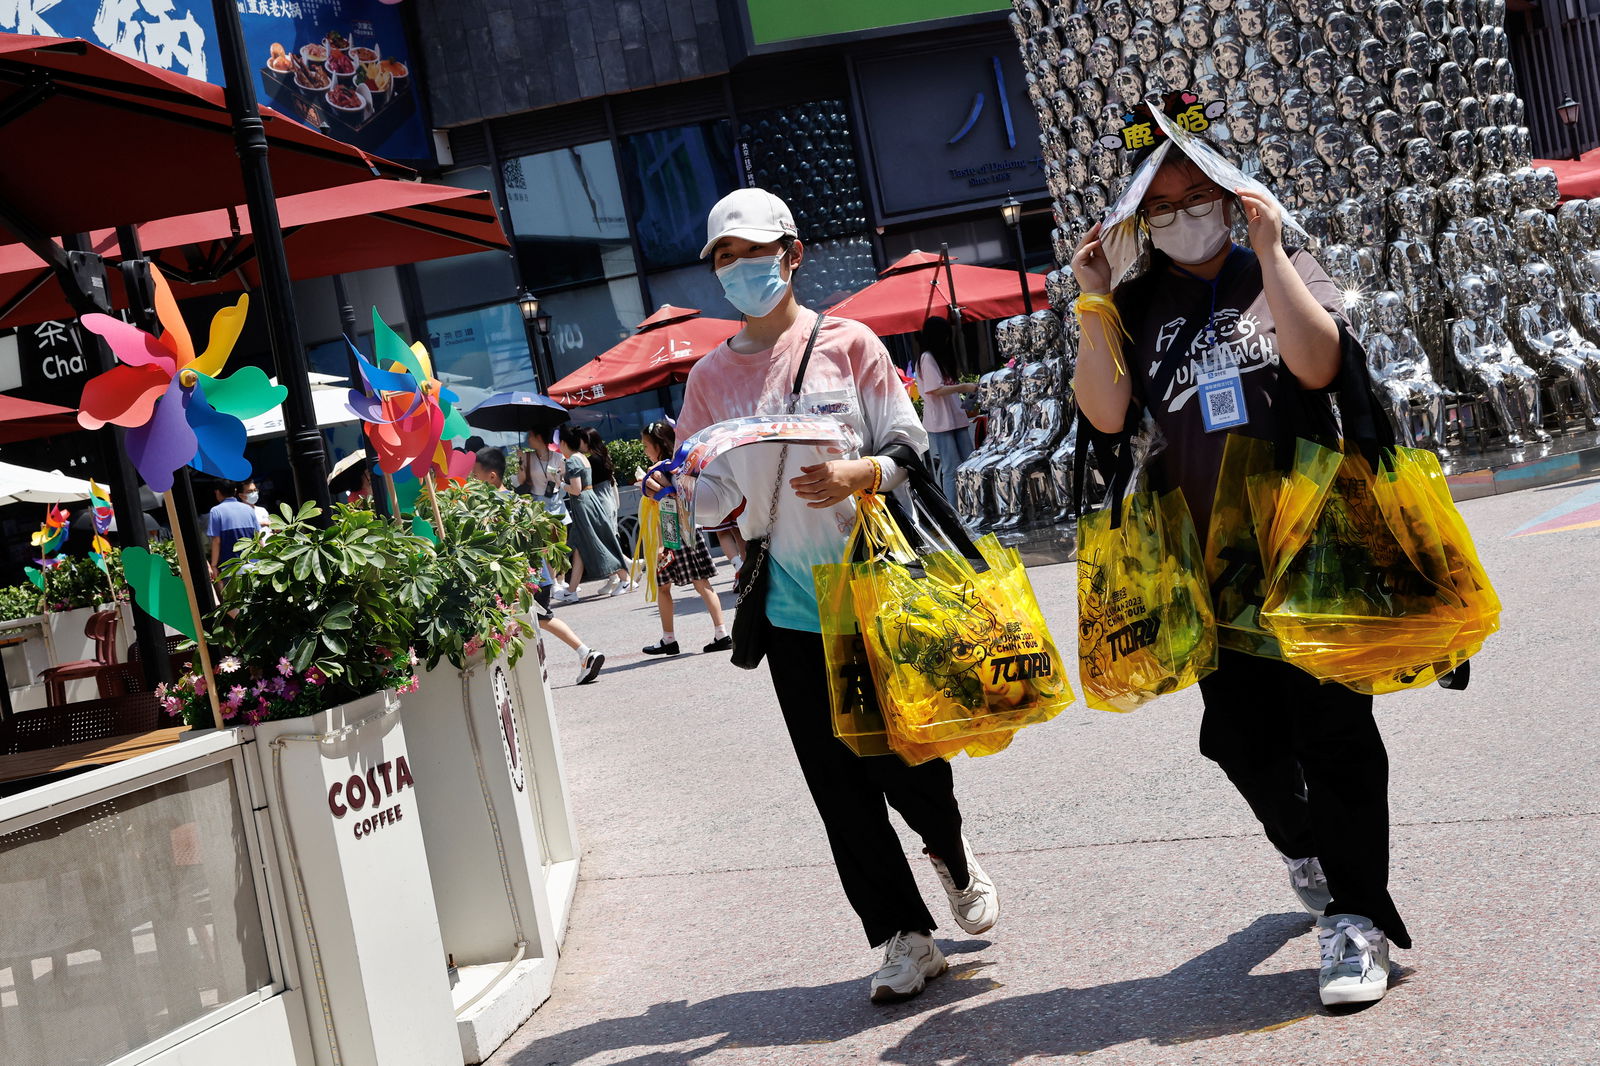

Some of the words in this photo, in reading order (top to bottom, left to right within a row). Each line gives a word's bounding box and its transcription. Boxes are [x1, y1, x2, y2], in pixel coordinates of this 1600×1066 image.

[560, 383, 607, 405] 小大董
[1125, 596, 1142, 608] 2023
[1125, 604, 1146, 619] TOUR
[328, 755, 414, 819] COSTA
[353, 804, 403, 840] COFFEE
